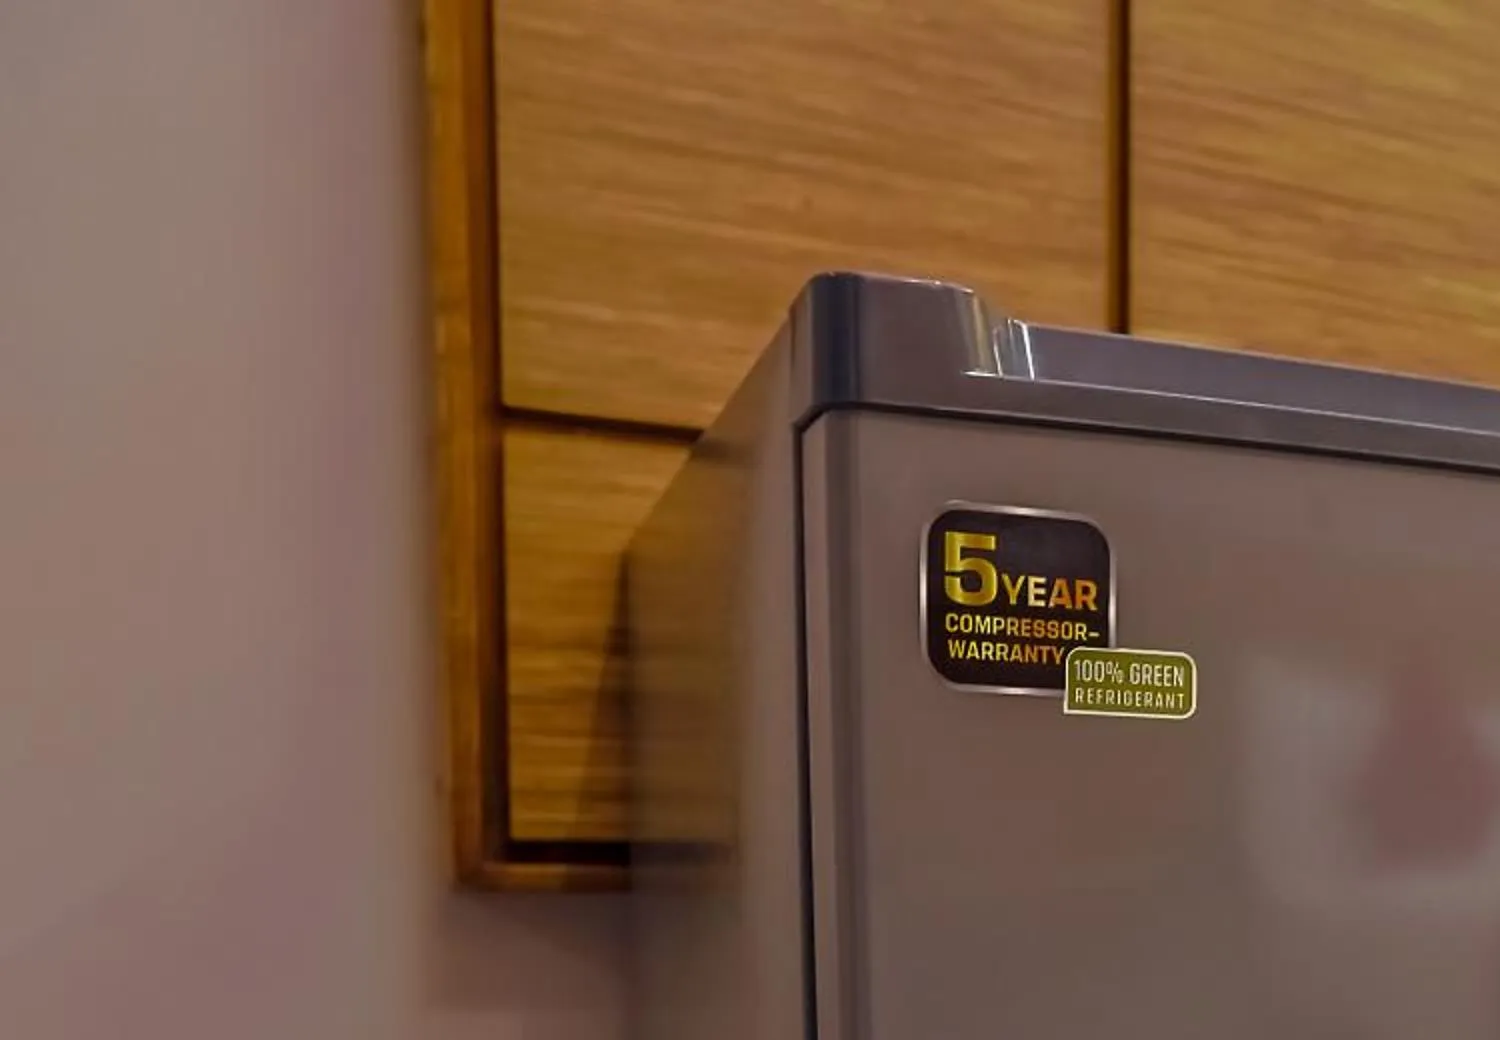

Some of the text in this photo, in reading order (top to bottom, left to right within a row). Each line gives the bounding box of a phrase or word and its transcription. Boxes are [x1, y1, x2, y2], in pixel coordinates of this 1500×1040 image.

[944, 531, 1098, 611] 5 YEAR
[948, 639, 1065, 665] WARRANTY
[1074, 659, 1185, 688] 100% GREEN
[1075, 687, 1185, 710] REFRIGERANT
